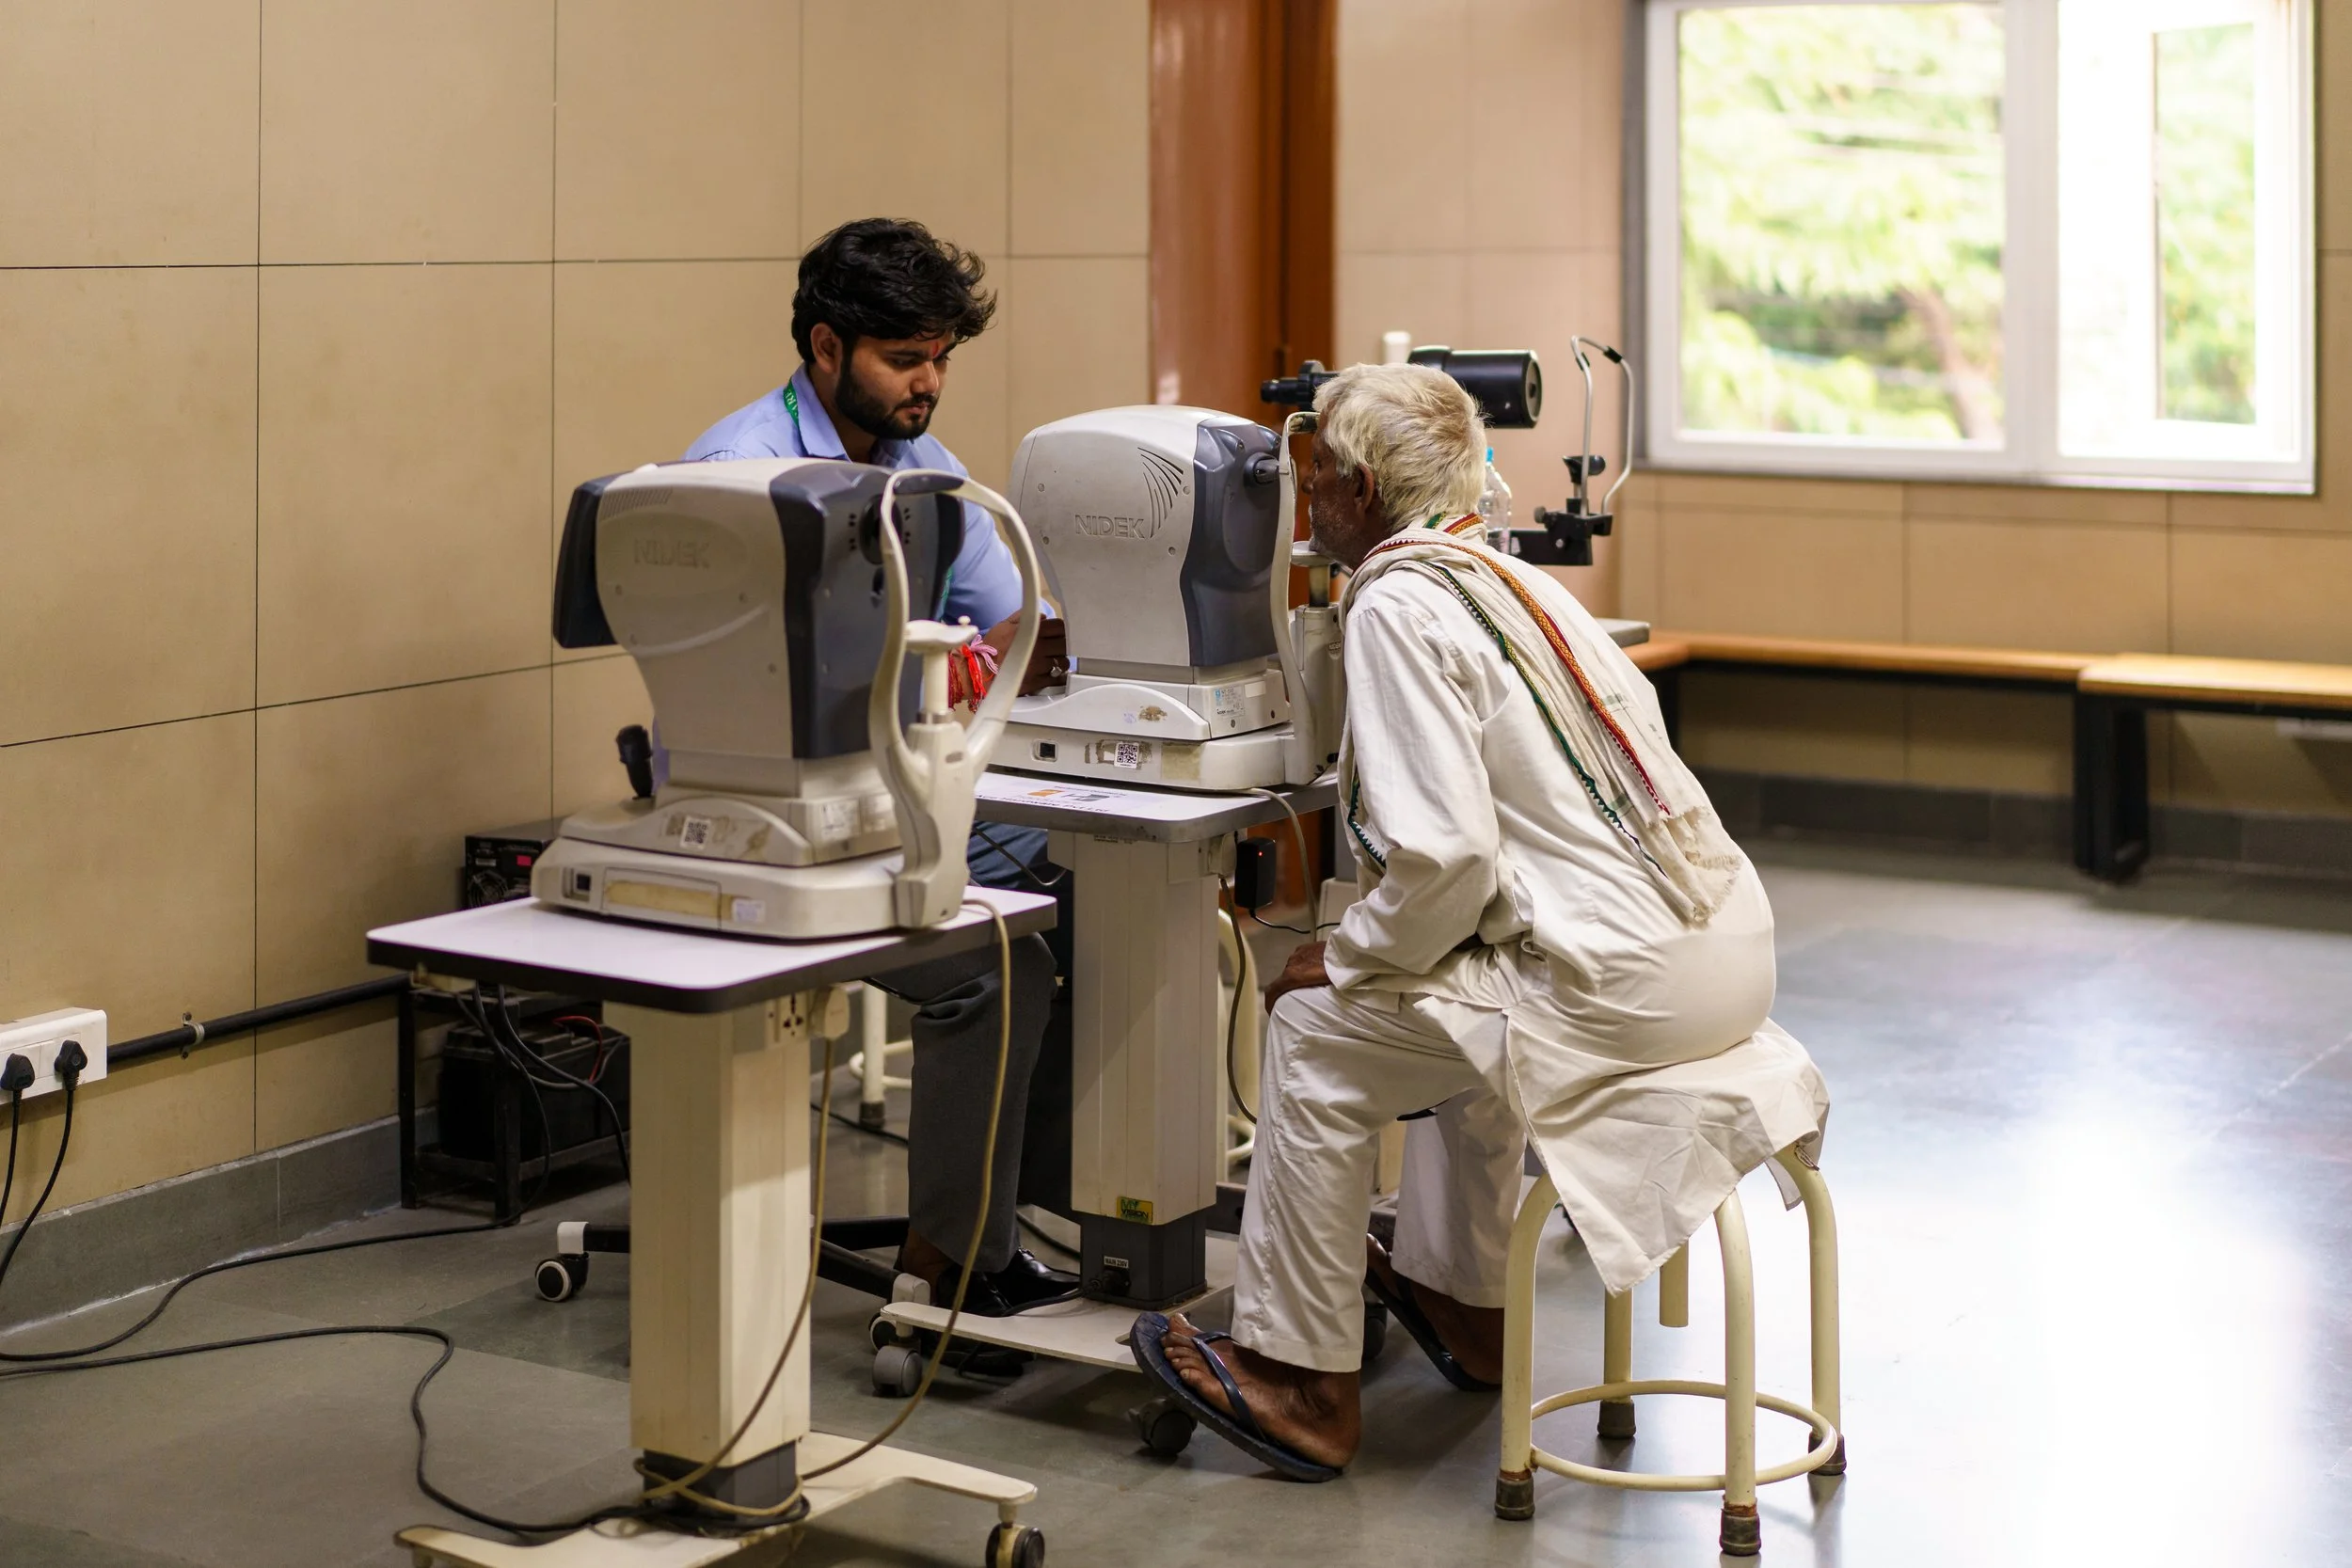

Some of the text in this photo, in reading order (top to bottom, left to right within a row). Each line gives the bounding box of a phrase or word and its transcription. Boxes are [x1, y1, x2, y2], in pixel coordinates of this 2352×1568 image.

[1074, 515, 1145, 539] NIDEK
[1120, 1209, 1149, 1219] VISION
[1105, 1258, 1116, 1266] MAIN
